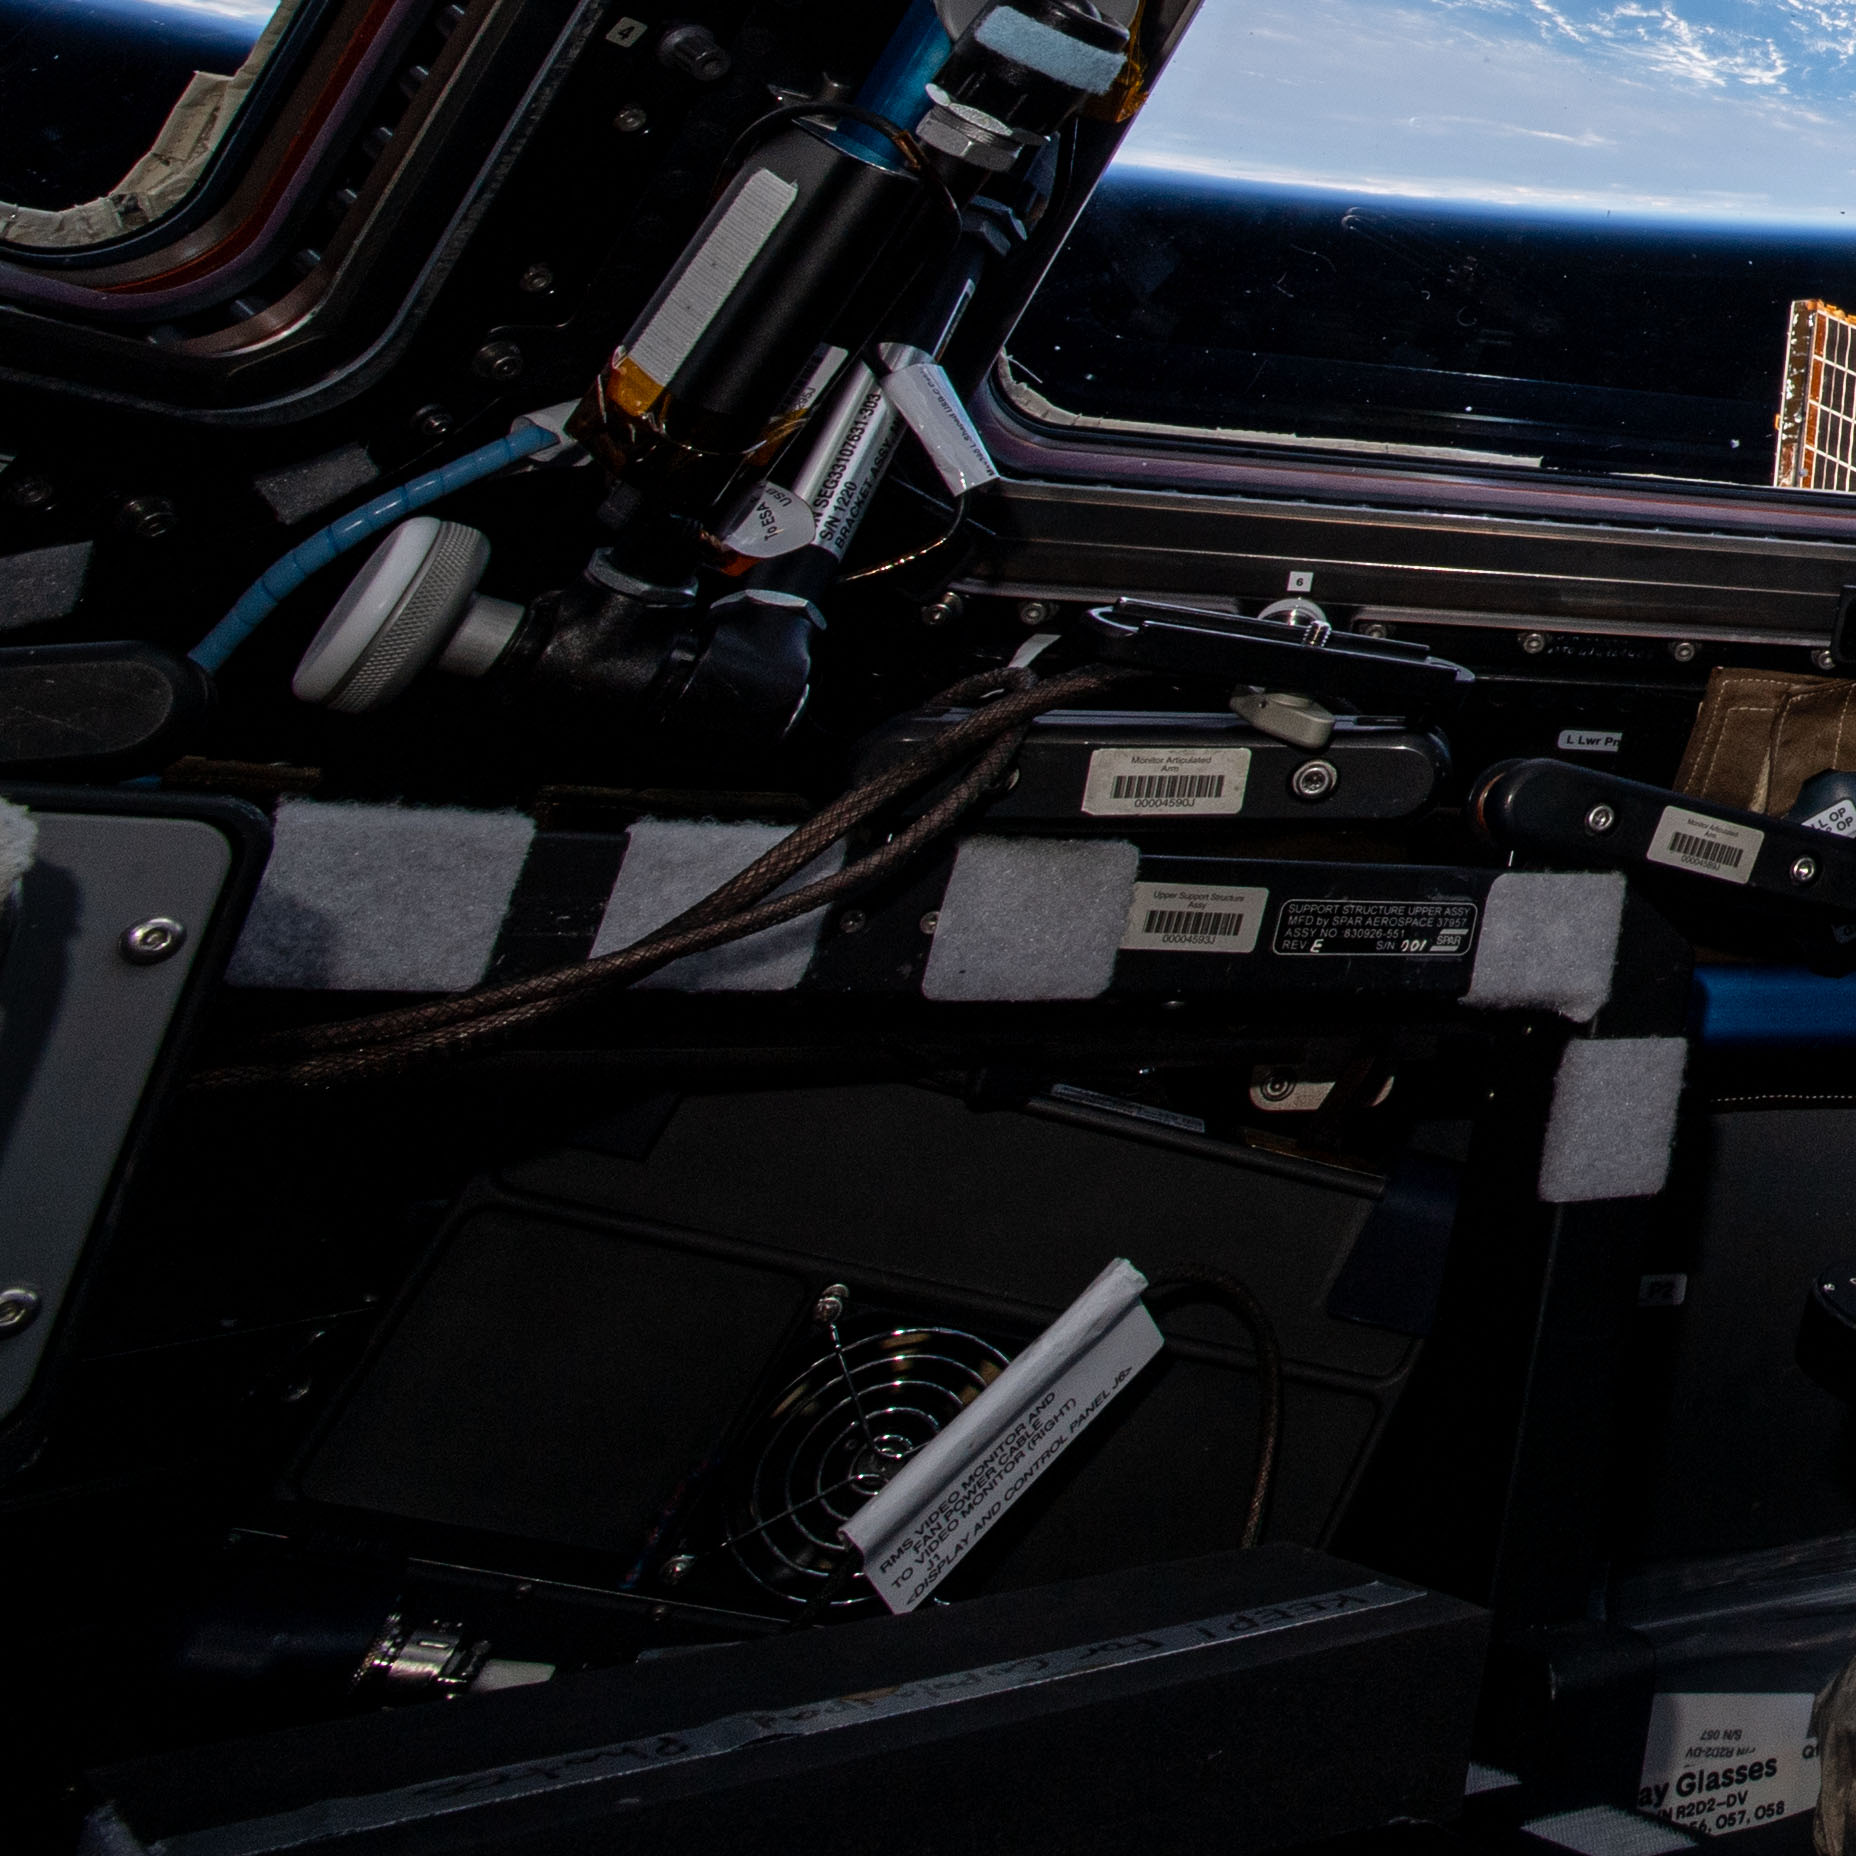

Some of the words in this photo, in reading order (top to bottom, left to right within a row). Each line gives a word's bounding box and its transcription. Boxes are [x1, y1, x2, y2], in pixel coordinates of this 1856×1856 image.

[616, 25, 636, 40] 4
[814, 393, 880, 508] SEG33107631-303
[835, 480, 874, 550] BRACKET
[869, 438, 890, 480] ASSY
[756, 502, 776, 528] ESA
[820, 512, 840, 542] S/N
[833, 482, 858, 512] 1220
[1578, 735, 1602, 746] Lwr
[1131, 756, 1164, 764] Monitor
[1166, 756, 1212, 764] Articulated
[1134, 798, 1196, 808] 00004590J
[1153, 890, 1178, 900] Upper
[1178, 891, 1210, 902] Support
[1210, 893, 1246, 902] Structure
[1287, 903, 1340, 914] SUPPORT
[1341, 904, 1406, 916] STRUCTURE
[1407, 905, 1442, 916] UPPER
[1443, 906, 1472, 918] ASSY
[1287, 915, 1314, 926] MFD
[1316, 916, 1328, 928] by
[1331, 916, 1364, 926] SPAR
[1364, 917, 1434, 928] AEROSPACE
[1436, 918, 1468, 928] 37957
[1284, 927, 1316, 938] ASSY
[1436, 936, 1462, 946] SPAR
[1309, 938, 1326, 954] E
[973, 1501, 1002, 1536] AND
[1003, 1435, 1068, 1502] CONTROL
[1068, 1390, 1112, 1434] PANEL
[880, 1538, 914, 1574] RMS
[914, 1494, 962, 1536] VIDEO
[962, 1422, 1028, 1490] MONITOR
[1026, 1392, 1056, 1424] AND
[913, 1522, 942, 1554] FAN
[943, 1466, 1000, 1522] POWER
[999, 1419, 1046, 1466] CABLE
[891, 1567, 914, 1590] TO
[914, 1521, 962, 1566] VIDEO
[961, 1451, 1028, 1518] MONITOR
[1026, 1398, 1078, 1452] (RIGHT)
[927, 1553, 942, 1572] J1
[1723, 1729, 1742, 1742] S/N
[1676, 1758, 1778, 1798] Glasses
[1676, 1790, 1748, 1820] R2D2-DV
